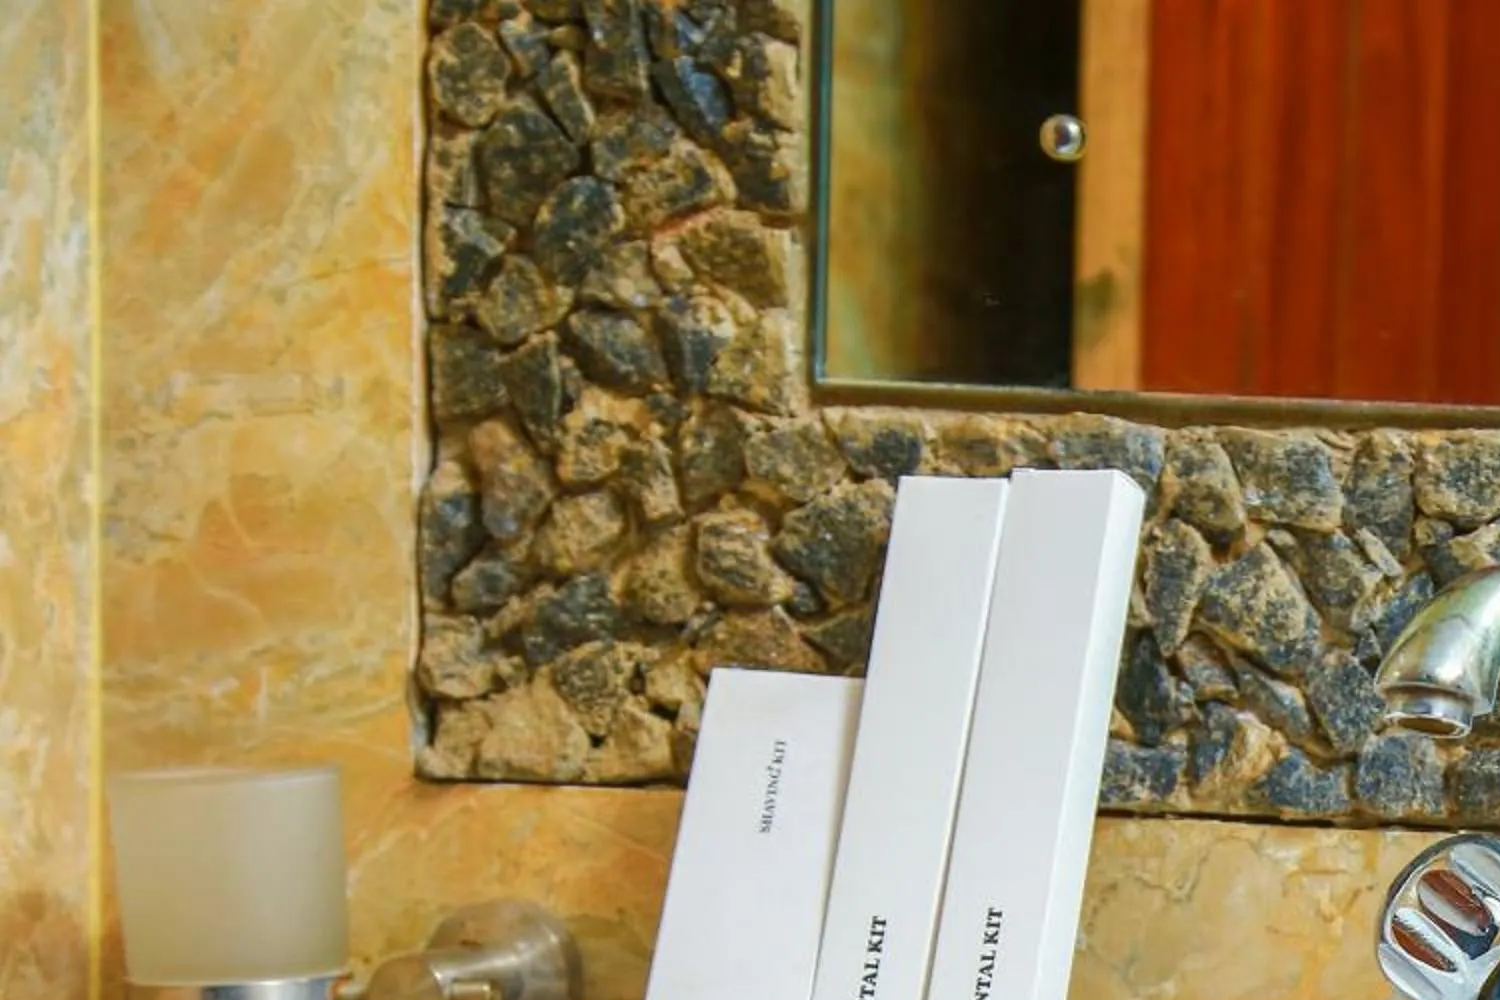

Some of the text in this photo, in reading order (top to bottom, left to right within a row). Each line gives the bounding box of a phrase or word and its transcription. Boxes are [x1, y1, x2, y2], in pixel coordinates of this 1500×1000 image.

[772, 739, 787, 764] KIT
[866, 915, 887, 953] KIT
[983, 907, 1003, 945] KIT
